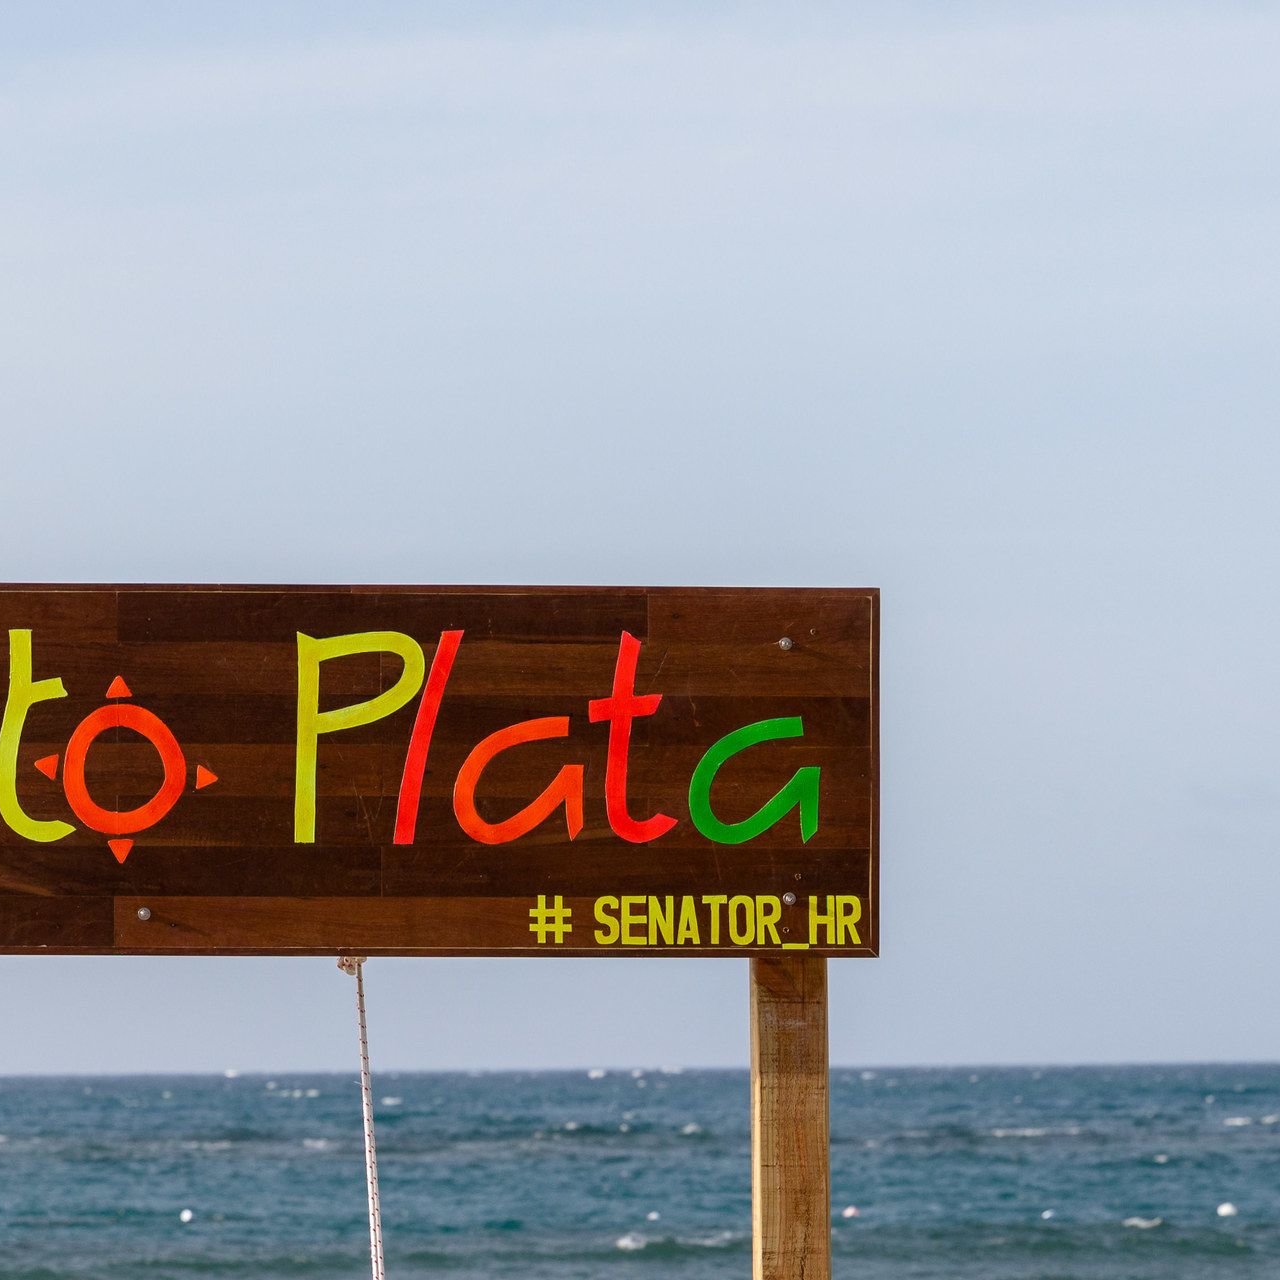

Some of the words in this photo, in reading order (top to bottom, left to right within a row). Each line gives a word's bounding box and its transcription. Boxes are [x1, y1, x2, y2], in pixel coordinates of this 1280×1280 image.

[293, 629, 821, 845] Plata
[528, 894, 573, 944] #
[592, 894, 862, 950] SENATOR_HR
